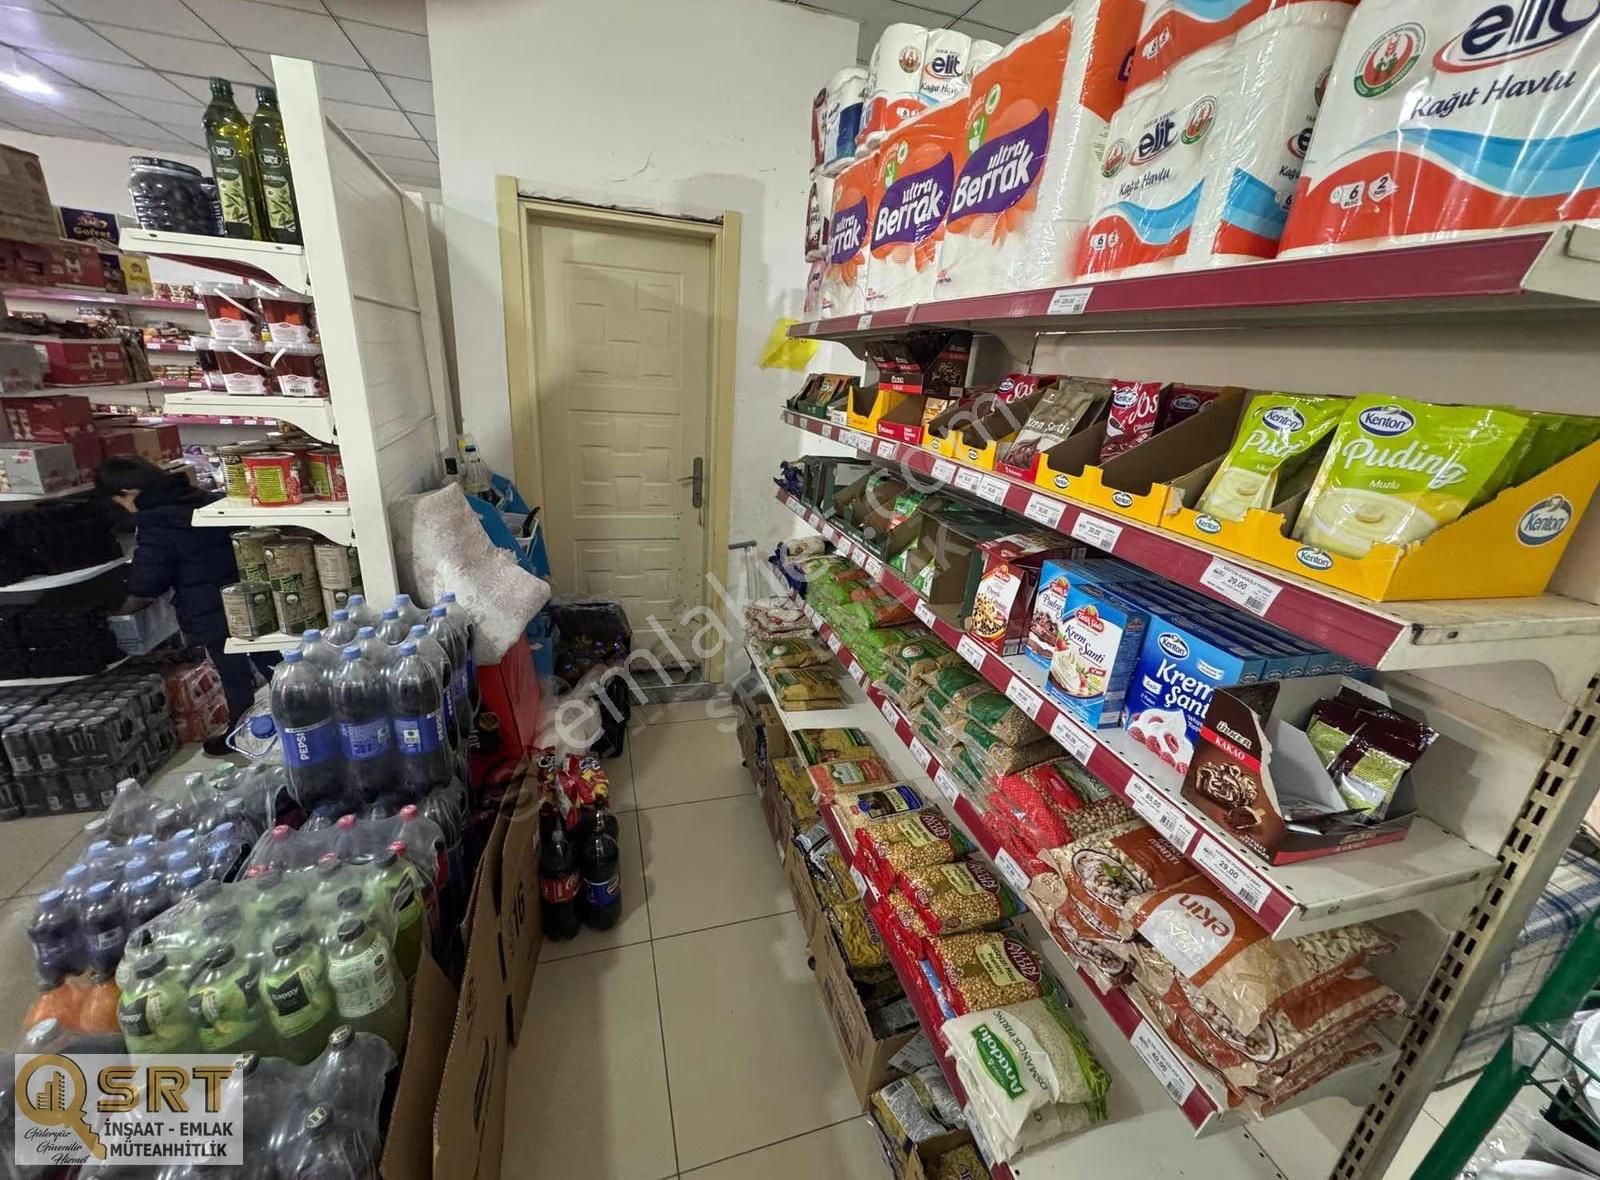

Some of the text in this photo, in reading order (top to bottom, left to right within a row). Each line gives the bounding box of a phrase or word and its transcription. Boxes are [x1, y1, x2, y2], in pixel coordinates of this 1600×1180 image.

[931, 54, 963, 78] elit
[1411, 69, 1577, 120] Kağıt Havlu
[1138, 118, 1177, 158] elit
[987, 138, 1025, 169] ultra
[902, 178, 934, 206] ultra
[950, 150, 1034, 215] Berrak
[1350, 186, 1358, 199] 6
[1378, 176, 1388, 190] 2
[874, 186, 944, 242] Berrak
[1364, 414, 1411, 432] Kenton
[1343, 438, 1469, 486] Puding
[1197, 516, 1220, 532] Kenton
[1523, 507, 1571, 535] Kenton
[1299, 550, 1333, 569] Kenton
[1064, 624, 1088, 644] Krem
[1161, 637, 1186, 655] Kenton
[1156, 657, 1214, 703] Krem
[1164, 684, 1210, 719] Şant
[298, 732, 311, 761] PEPSI
[1214, 735, 1247, 762] KAKAO
[1216, 720, 1252, 750] ÜLKER
[1179, 894, 1230, 939] ekin
[977, 1025, 1023, 1094] Anadolu
[1011, 1034, 1048, 1091] OSMANCIK
